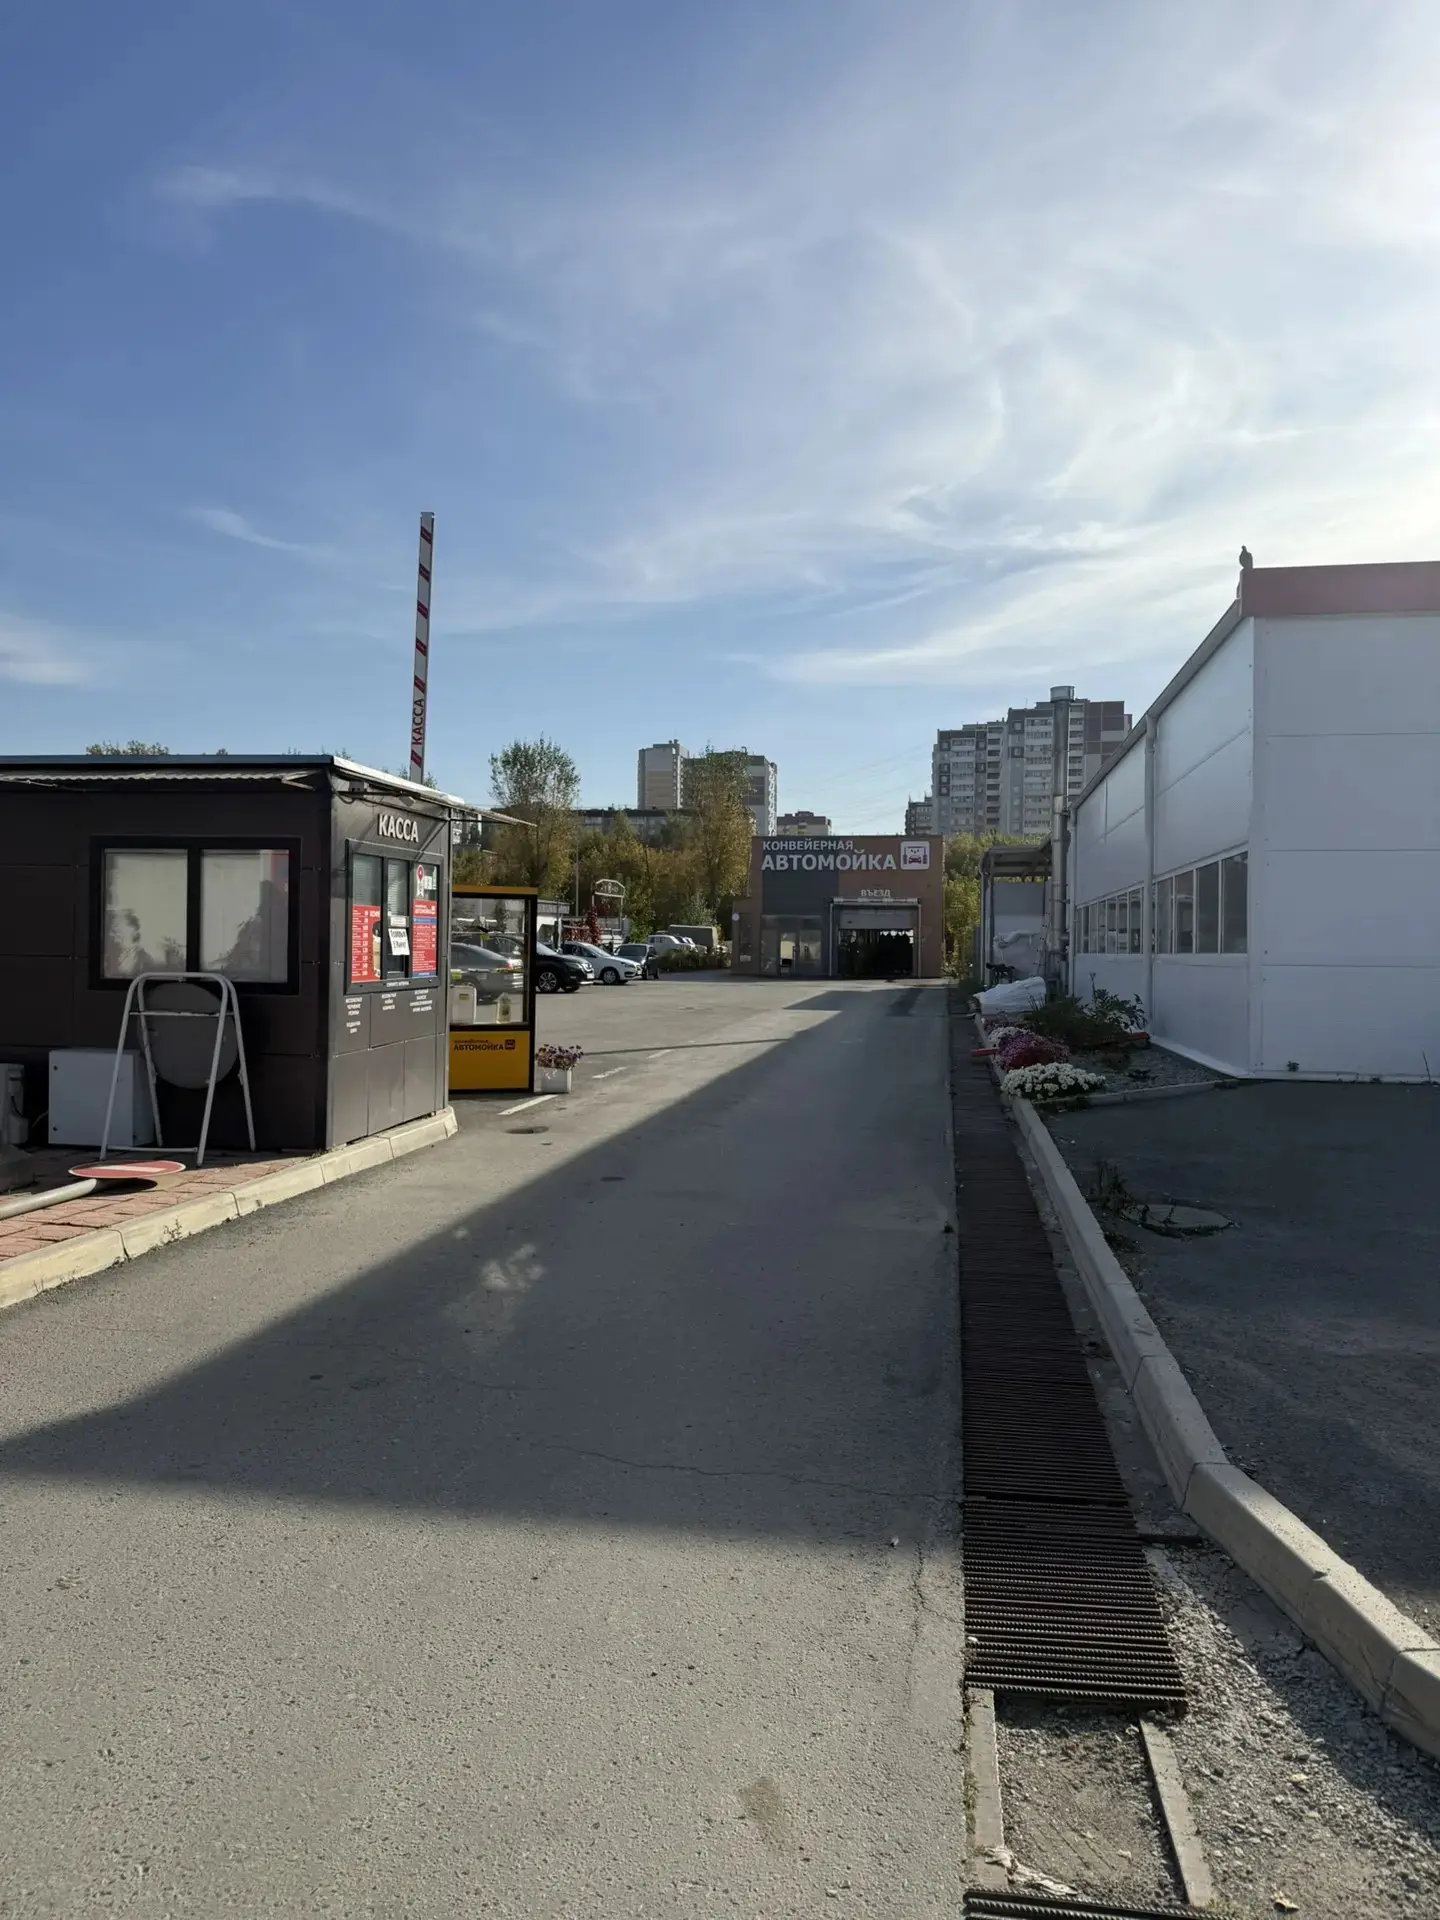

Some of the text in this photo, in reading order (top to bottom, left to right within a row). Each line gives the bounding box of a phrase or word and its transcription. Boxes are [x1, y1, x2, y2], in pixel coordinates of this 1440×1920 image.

[411, 699, 424, 745] КАССА
[378, 814, 419, 843] КАССА
[763, 838, 853, 850] КОНВЕЙЕРНАЯ
[761, 849, 896, 870] АВТОМОЙКА
[860, 889, 892, 897] ВЪЕЗД
